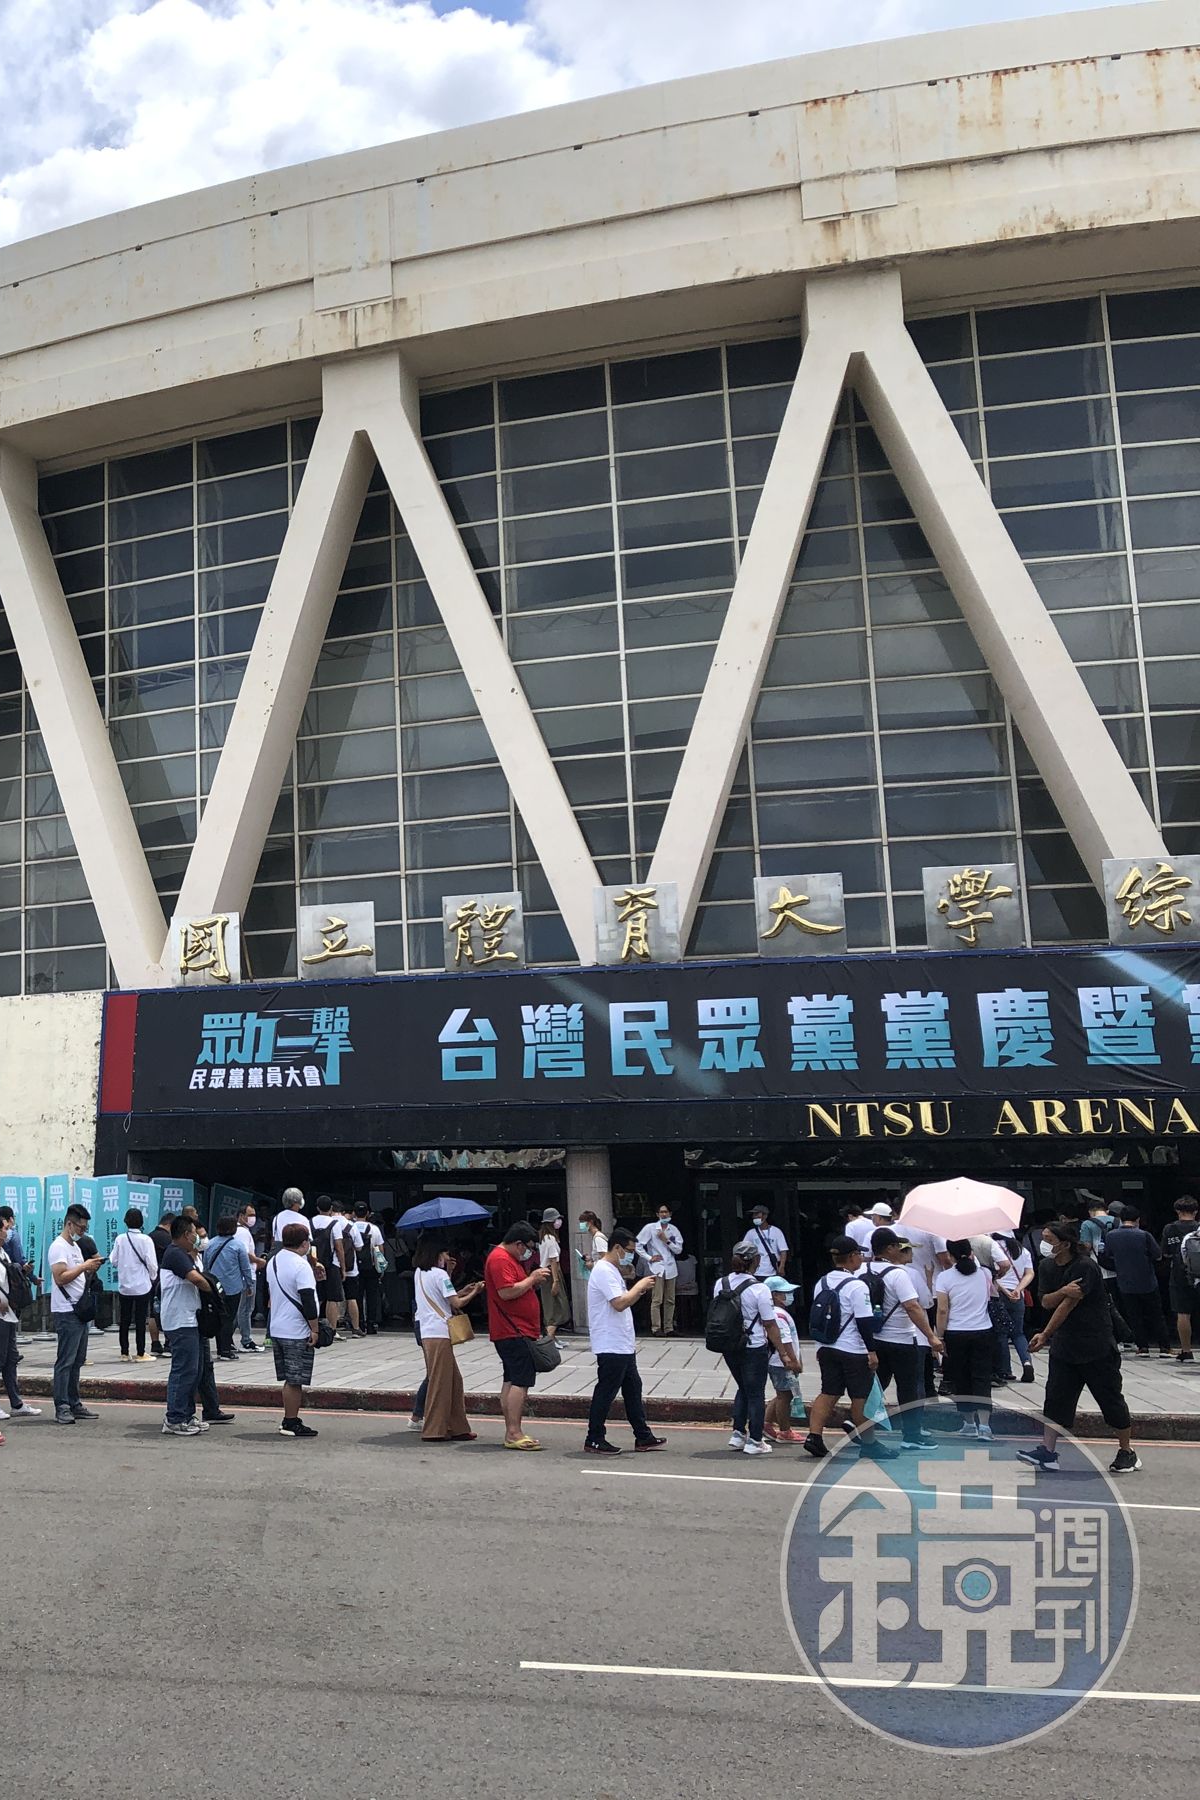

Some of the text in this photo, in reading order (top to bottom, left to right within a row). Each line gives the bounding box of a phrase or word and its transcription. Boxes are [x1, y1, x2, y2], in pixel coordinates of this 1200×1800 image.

[437, 984, 1200, 1081] 台灣民眾黨黨慶暨
[188, 1065, 322, 1090] 民眾黨黨員大會
[806, 1097, 1200, 1138] NTSU ARENA
